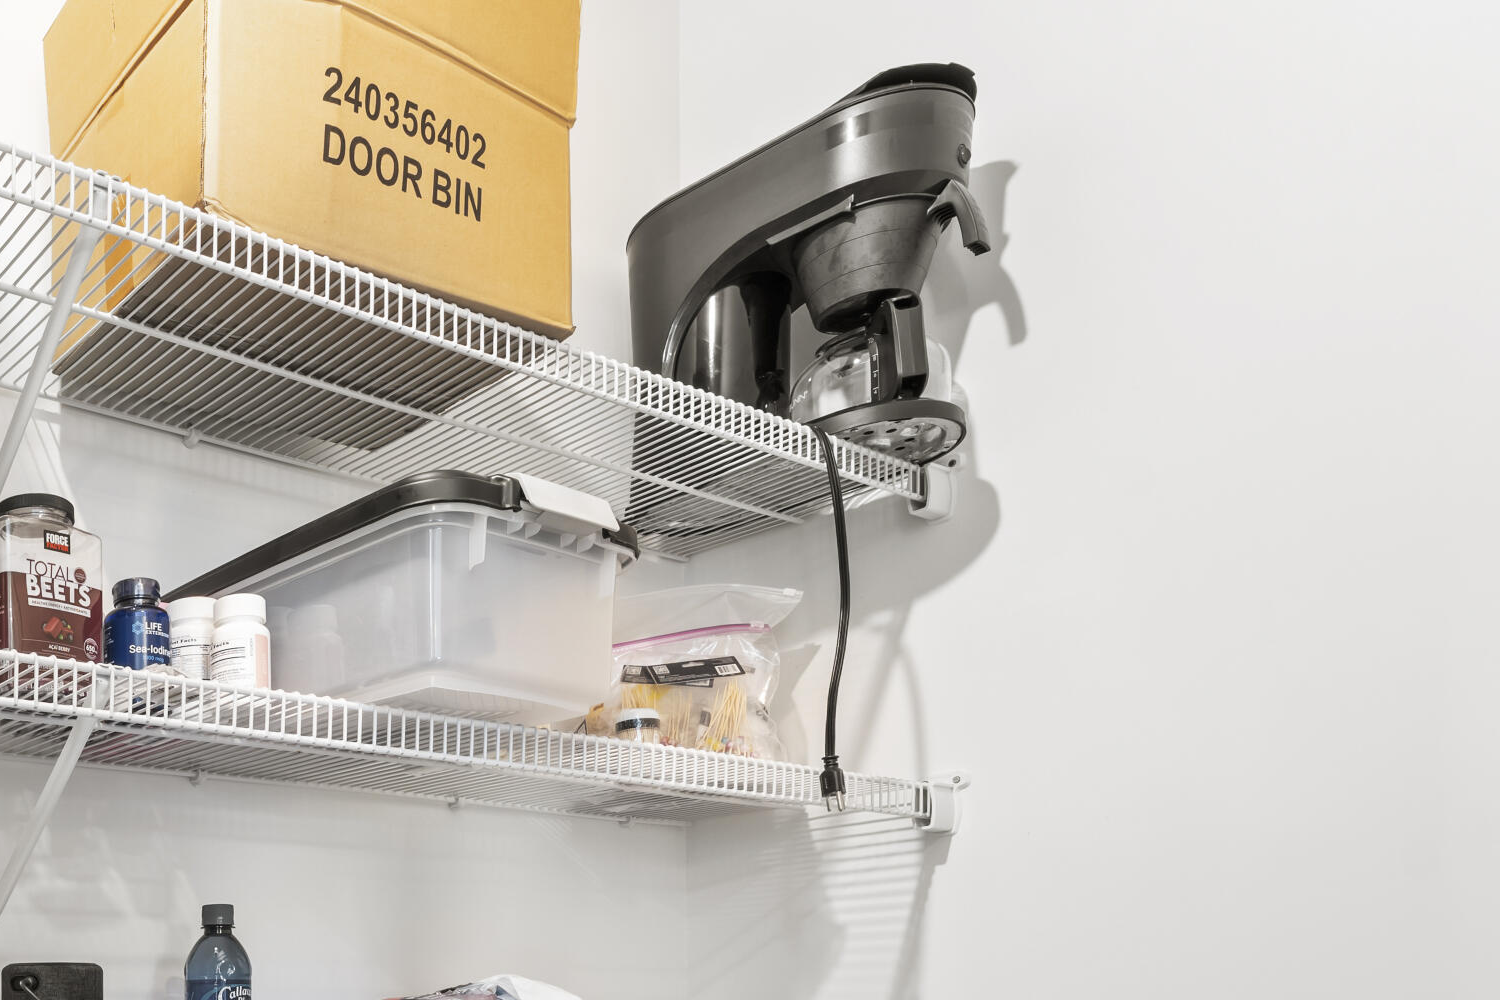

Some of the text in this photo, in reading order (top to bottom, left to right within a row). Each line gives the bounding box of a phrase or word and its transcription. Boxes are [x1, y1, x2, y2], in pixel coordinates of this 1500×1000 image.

[322, 66, 486, 170] 240356402
[322, 123, 482, 222] DOOR BIN
[46, 532, 69, 546] FORCE
[26, 558, 74, 583] TOTAL
[26, 573, 91, 607] BEETS
[145, 622, 162, 631] LIFE
